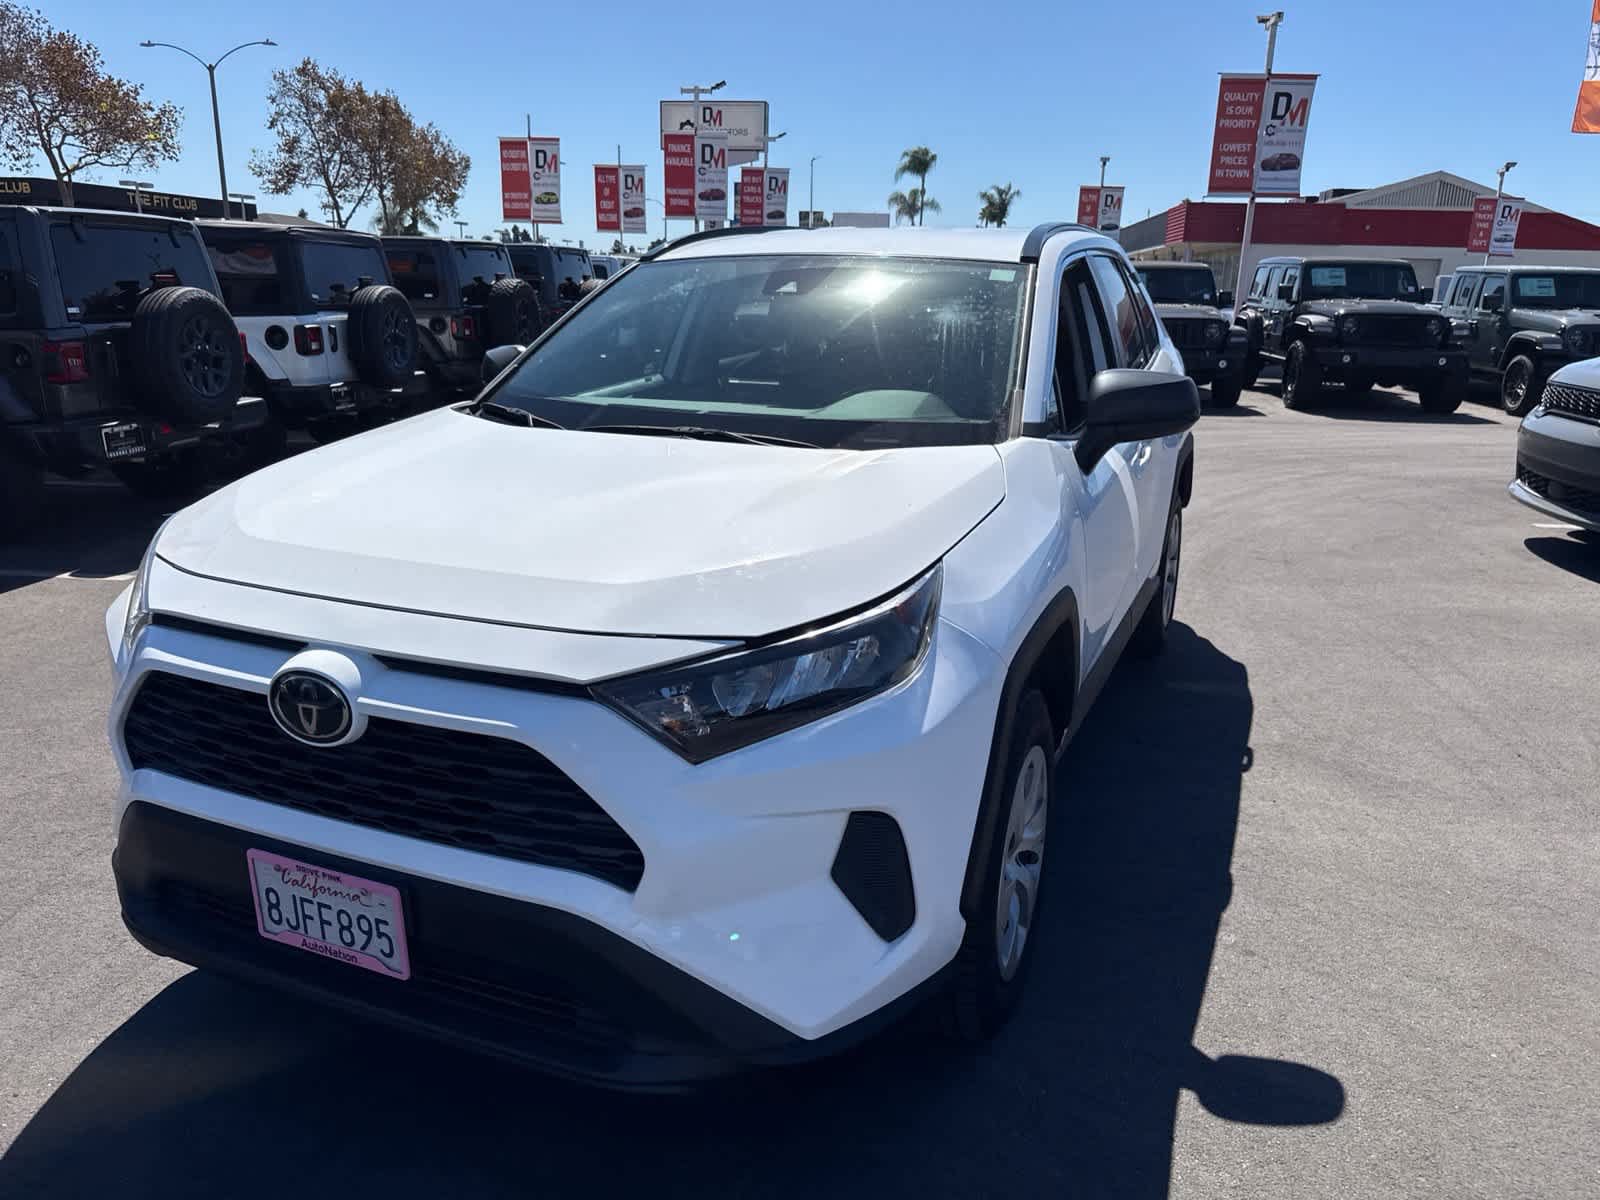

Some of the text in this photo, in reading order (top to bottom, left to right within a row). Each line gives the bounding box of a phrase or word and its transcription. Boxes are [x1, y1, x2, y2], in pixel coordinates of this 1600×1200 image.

[1223, 92, 1259, 102] QUALITY
[1226, 106, 1253, 115] IS OUR
[1219, 119, 1257, 128] PRIORITY
[1219, 143, 1252, 153] LOWEST
[1220, 156, 1248, 165] PRICES
[1216, 169, 1249, 178] IN TOWN
[152, 195, 170, 209] FIT
[172, 197, 198, 211] CLUB
[281, 866, 362, 903] California
[264, 887, 395, 959] 8JFF895
[301, 938, 358, 964] AutoNation
